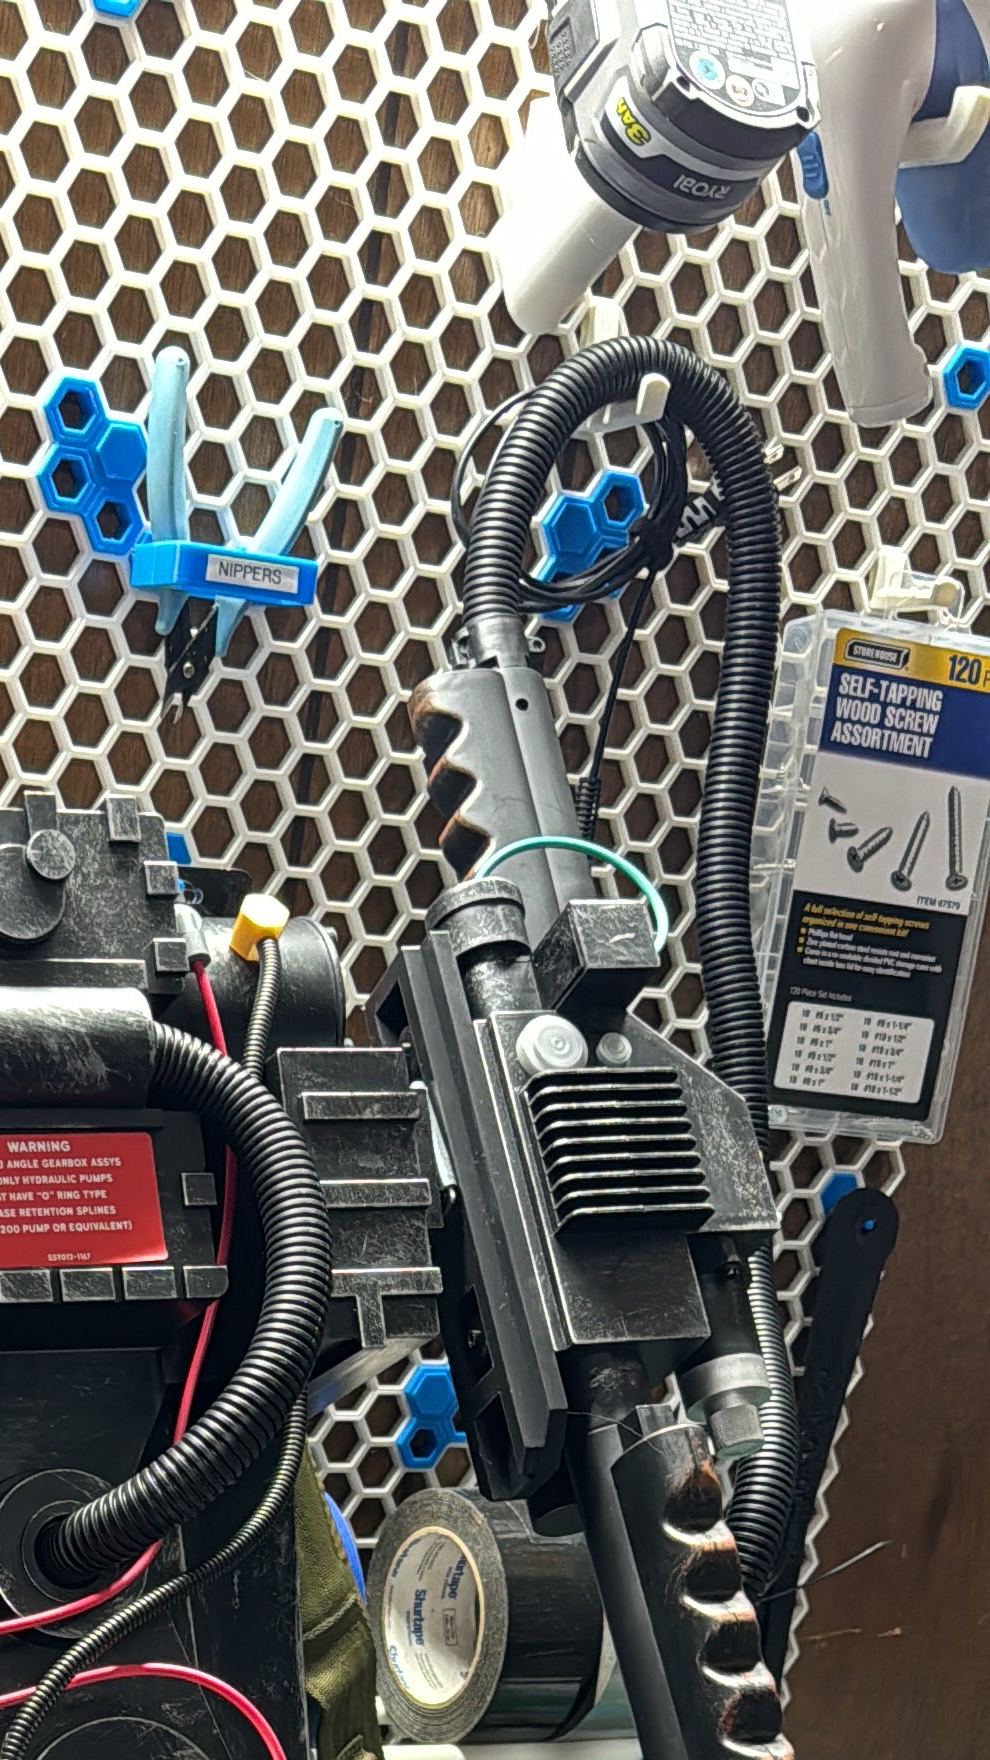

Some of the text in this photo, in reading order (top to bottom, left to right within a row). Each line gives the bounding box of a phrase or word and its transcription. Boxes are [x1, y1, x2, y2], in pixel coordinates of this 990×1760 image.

[672, 174, 731, 199] RYOBI
[218, 561, 282, 585] NIPPERS
[948, 654, 983, 686] 120
[839, 672, 943, 712] SELF-TAPPING
[835, 697, 939, 735] WOOD SCREW
[830, 721, 934, 758] ASSORTMENT
[917, 896, 937, 906] ITEM
[7, 1141, 71, 1153] WARNING
[7, 1159, 39, 1169] ANGLE
[42, 1158, 87, 1169] GEARBOX
[91, 1157, 121, 1167] ASSYS
[22, 1174, 77, 1185] HYDRAULIC
[79, 1173, 113, 1183] PUMPS
[9, 1192, 34, 1202] HAVE
[56, 1190, 80, 1200] RING
[83, 1190, 107, 1199] TYPE
[19, 1207, 73, 1217] RETENTION
[76, 1205, 116, 1216] SPLINES
[22, 1223, 50, 1233] PUMP
[52, 1222, 67, 1233] OR
[69, 1220, 133, 1232] EQUIVALENT)
[413, 1588, 427, 1647] Shurtape
